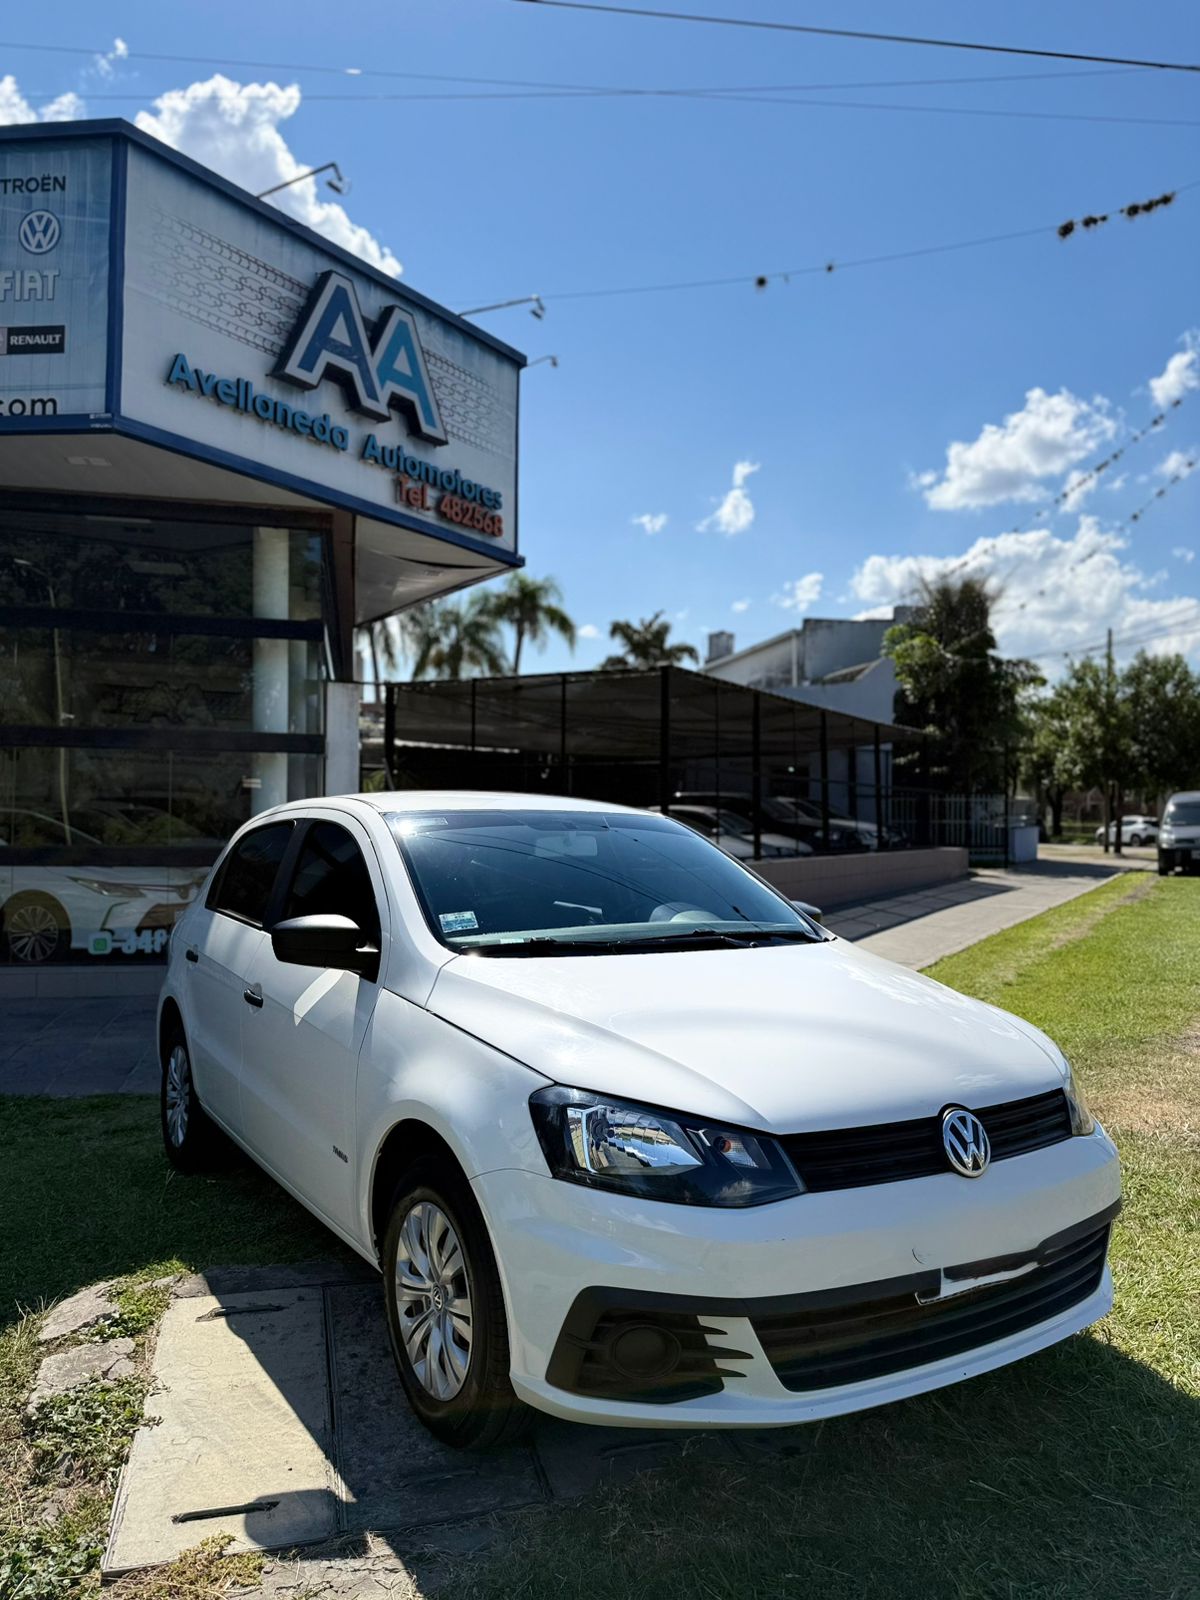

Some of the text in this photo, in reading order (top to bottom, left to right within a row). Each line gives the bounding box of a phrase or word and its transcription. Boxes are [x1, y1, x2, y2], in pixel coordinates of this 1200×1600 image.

[0, 268, 60, 301] FIAT
[10, 334, 62, 345] RENAULT
[168, 353, 503, 510] Avellaneda Automotores
[439, 493, 504, 537] 482568
